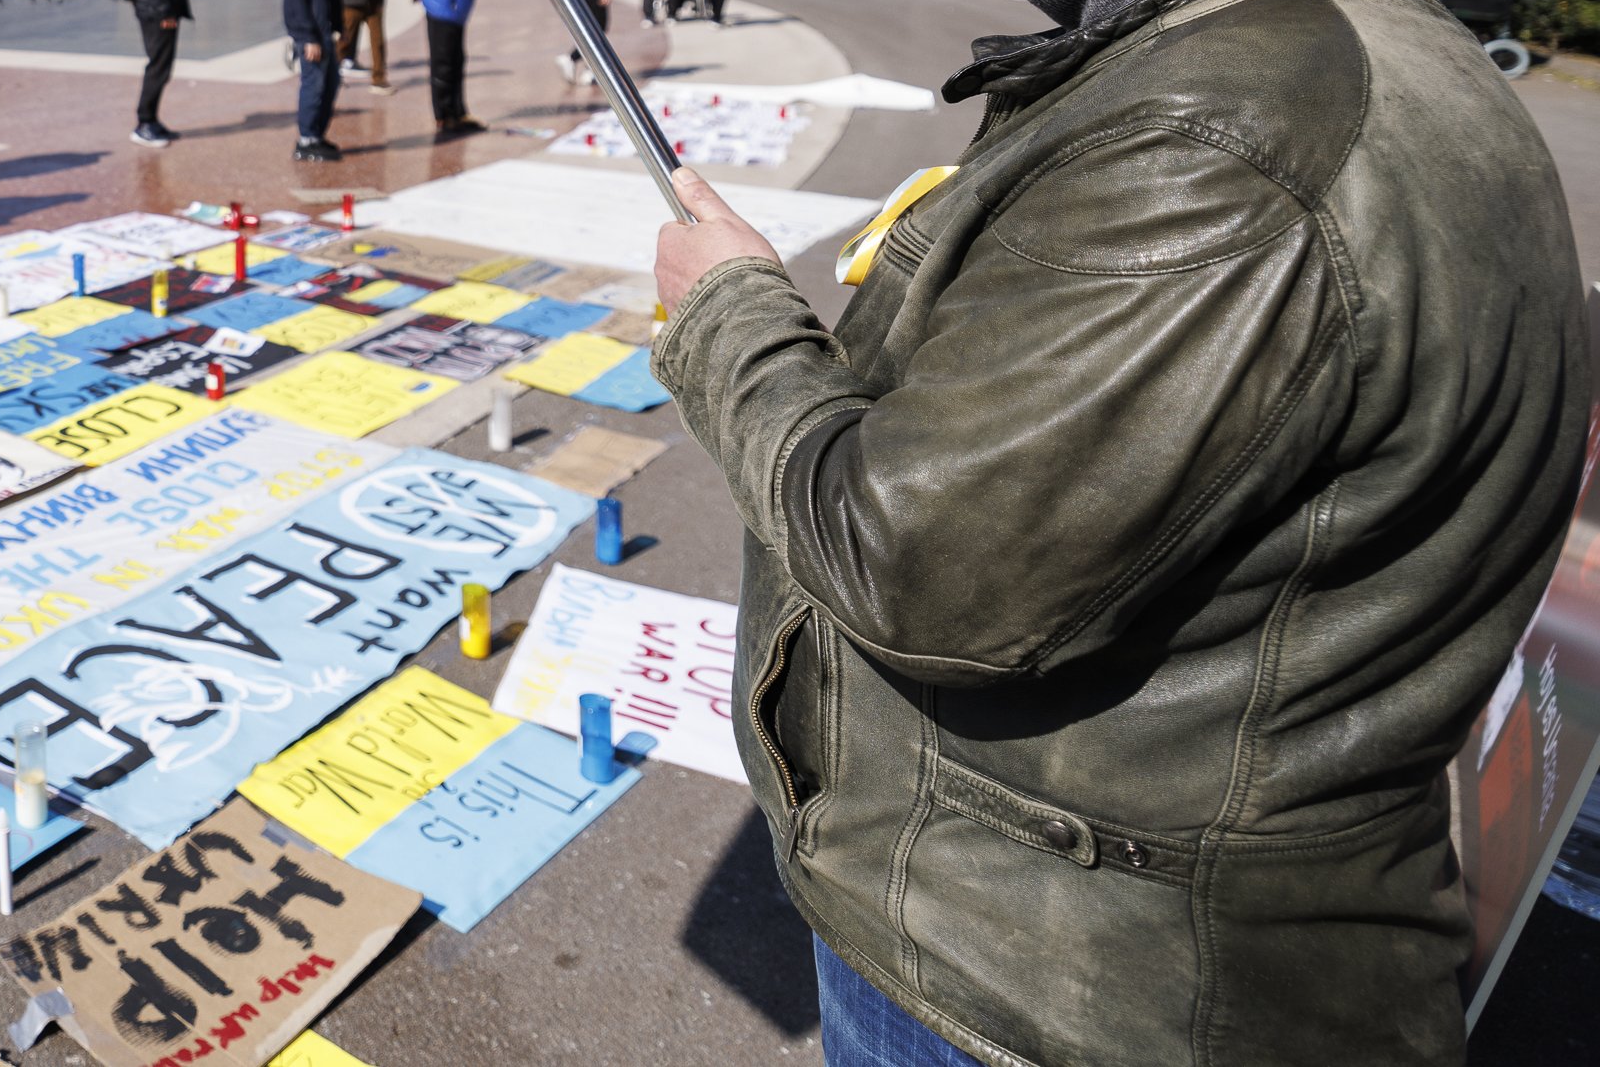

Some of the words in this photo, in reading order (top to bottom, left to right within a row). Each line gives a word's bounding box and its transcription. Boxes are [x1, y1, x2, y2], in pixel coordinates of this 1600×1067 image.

[35, 396, 182, 458] CLOSE
[106, 460, 261, 535] CLOSE
[618, 621, 680, 685] WAR
[1535, 642, 1558, 713] Hoy
[346, 691, 494, 778] World
[276, 759, 397, 817] War
[458, 761, 599, 820] This
[418, 815, 482, 851] is
